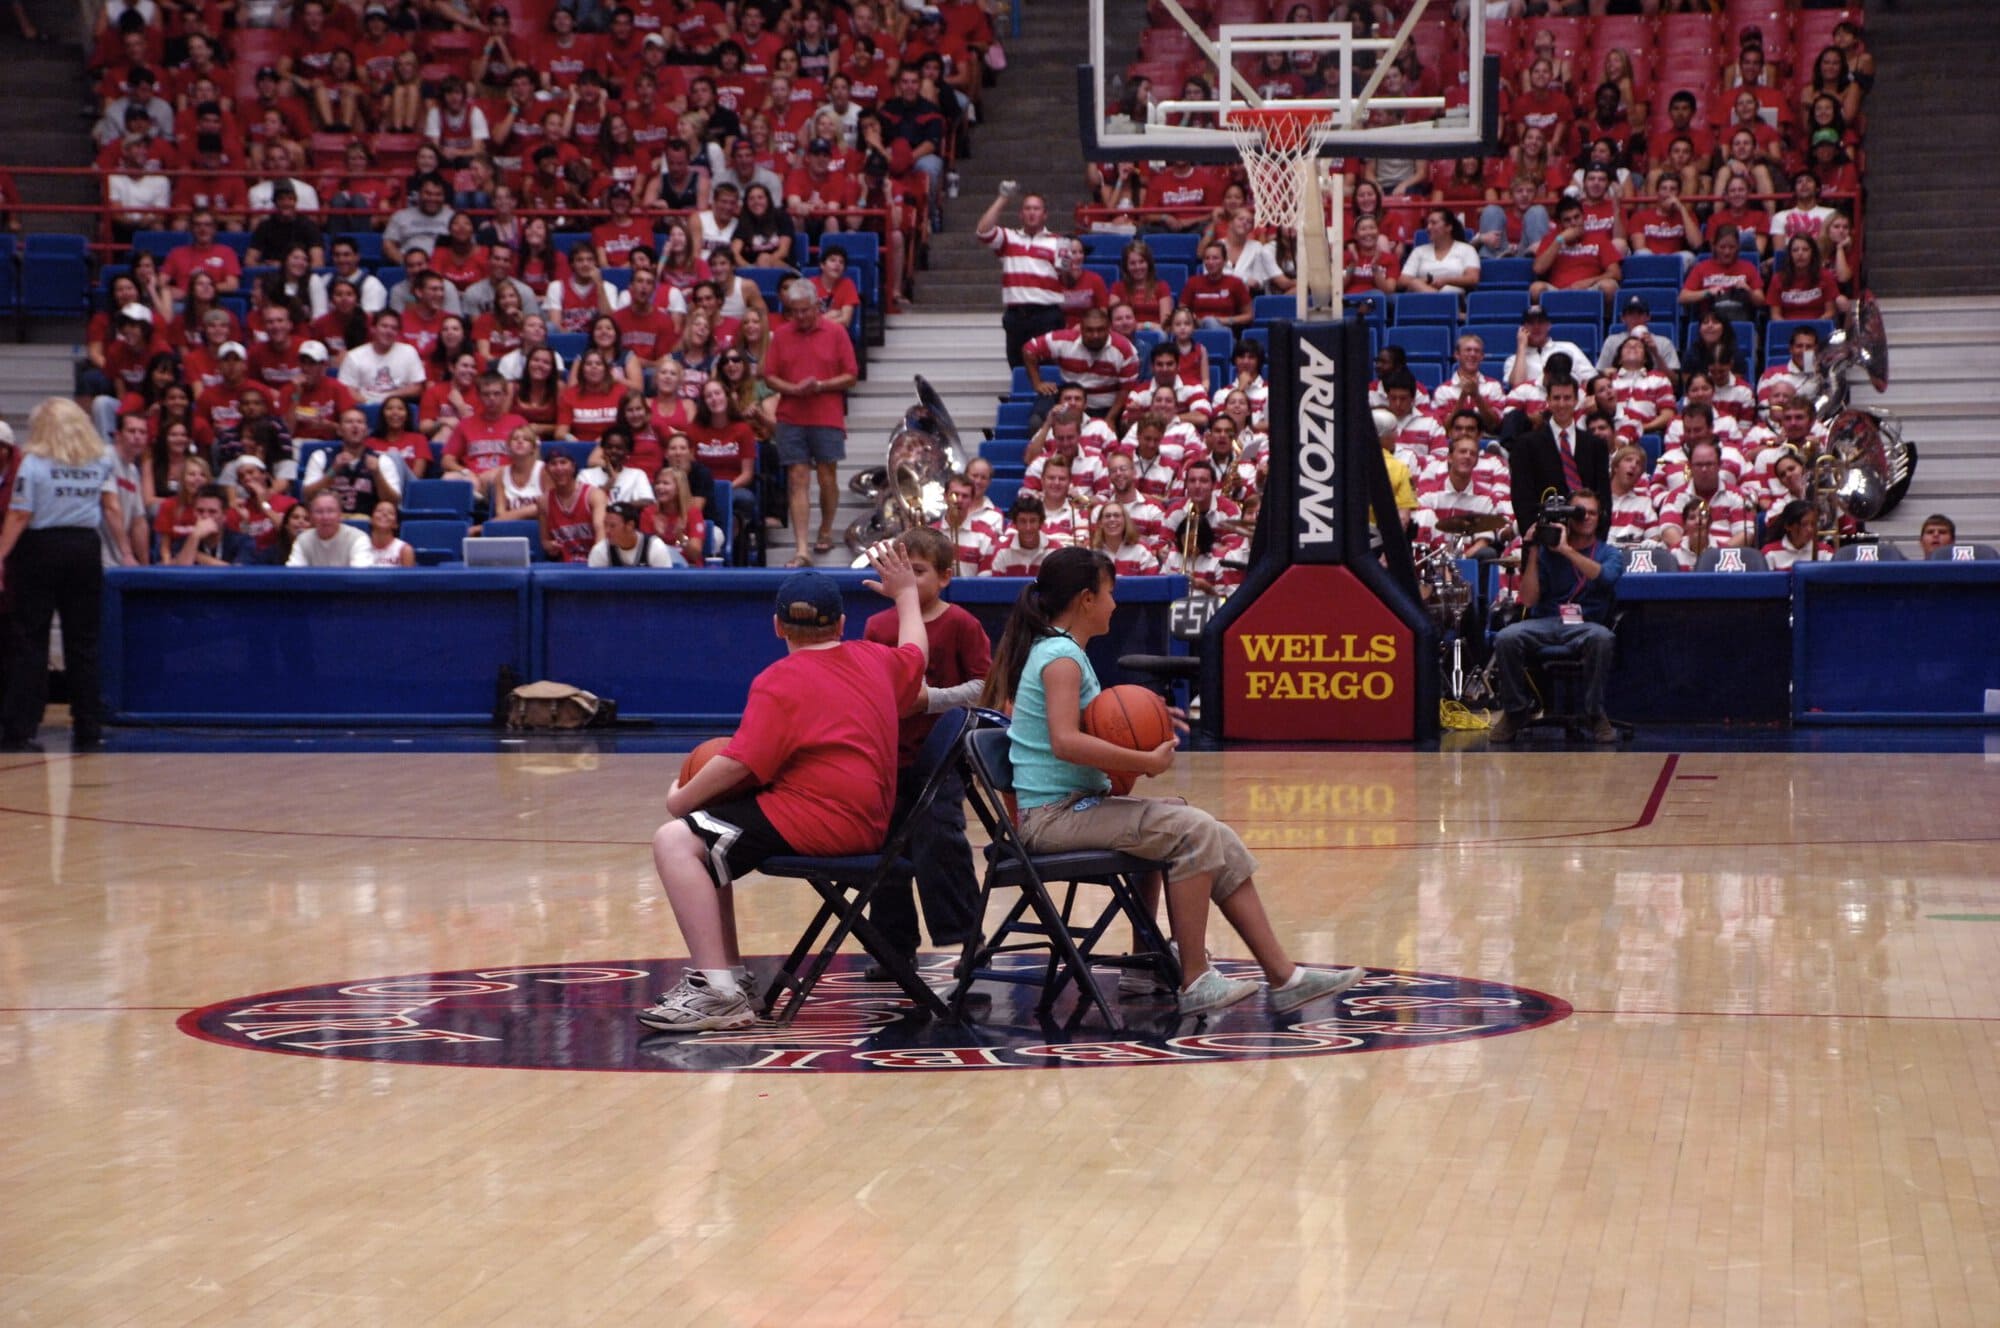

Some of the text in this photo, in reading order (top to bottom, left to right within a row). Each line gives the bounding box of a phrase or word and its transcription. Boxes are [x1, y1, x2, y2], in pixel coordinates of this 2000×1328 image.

[1299, 336, 1335, 543] ARIZONA
[50, 469, 98, 479] EVENT
[54, 487, 98, 497] STAFF
[1240, 635, 1396, 662] WELLS
[1245, 671, 1394, 700] FARGO
